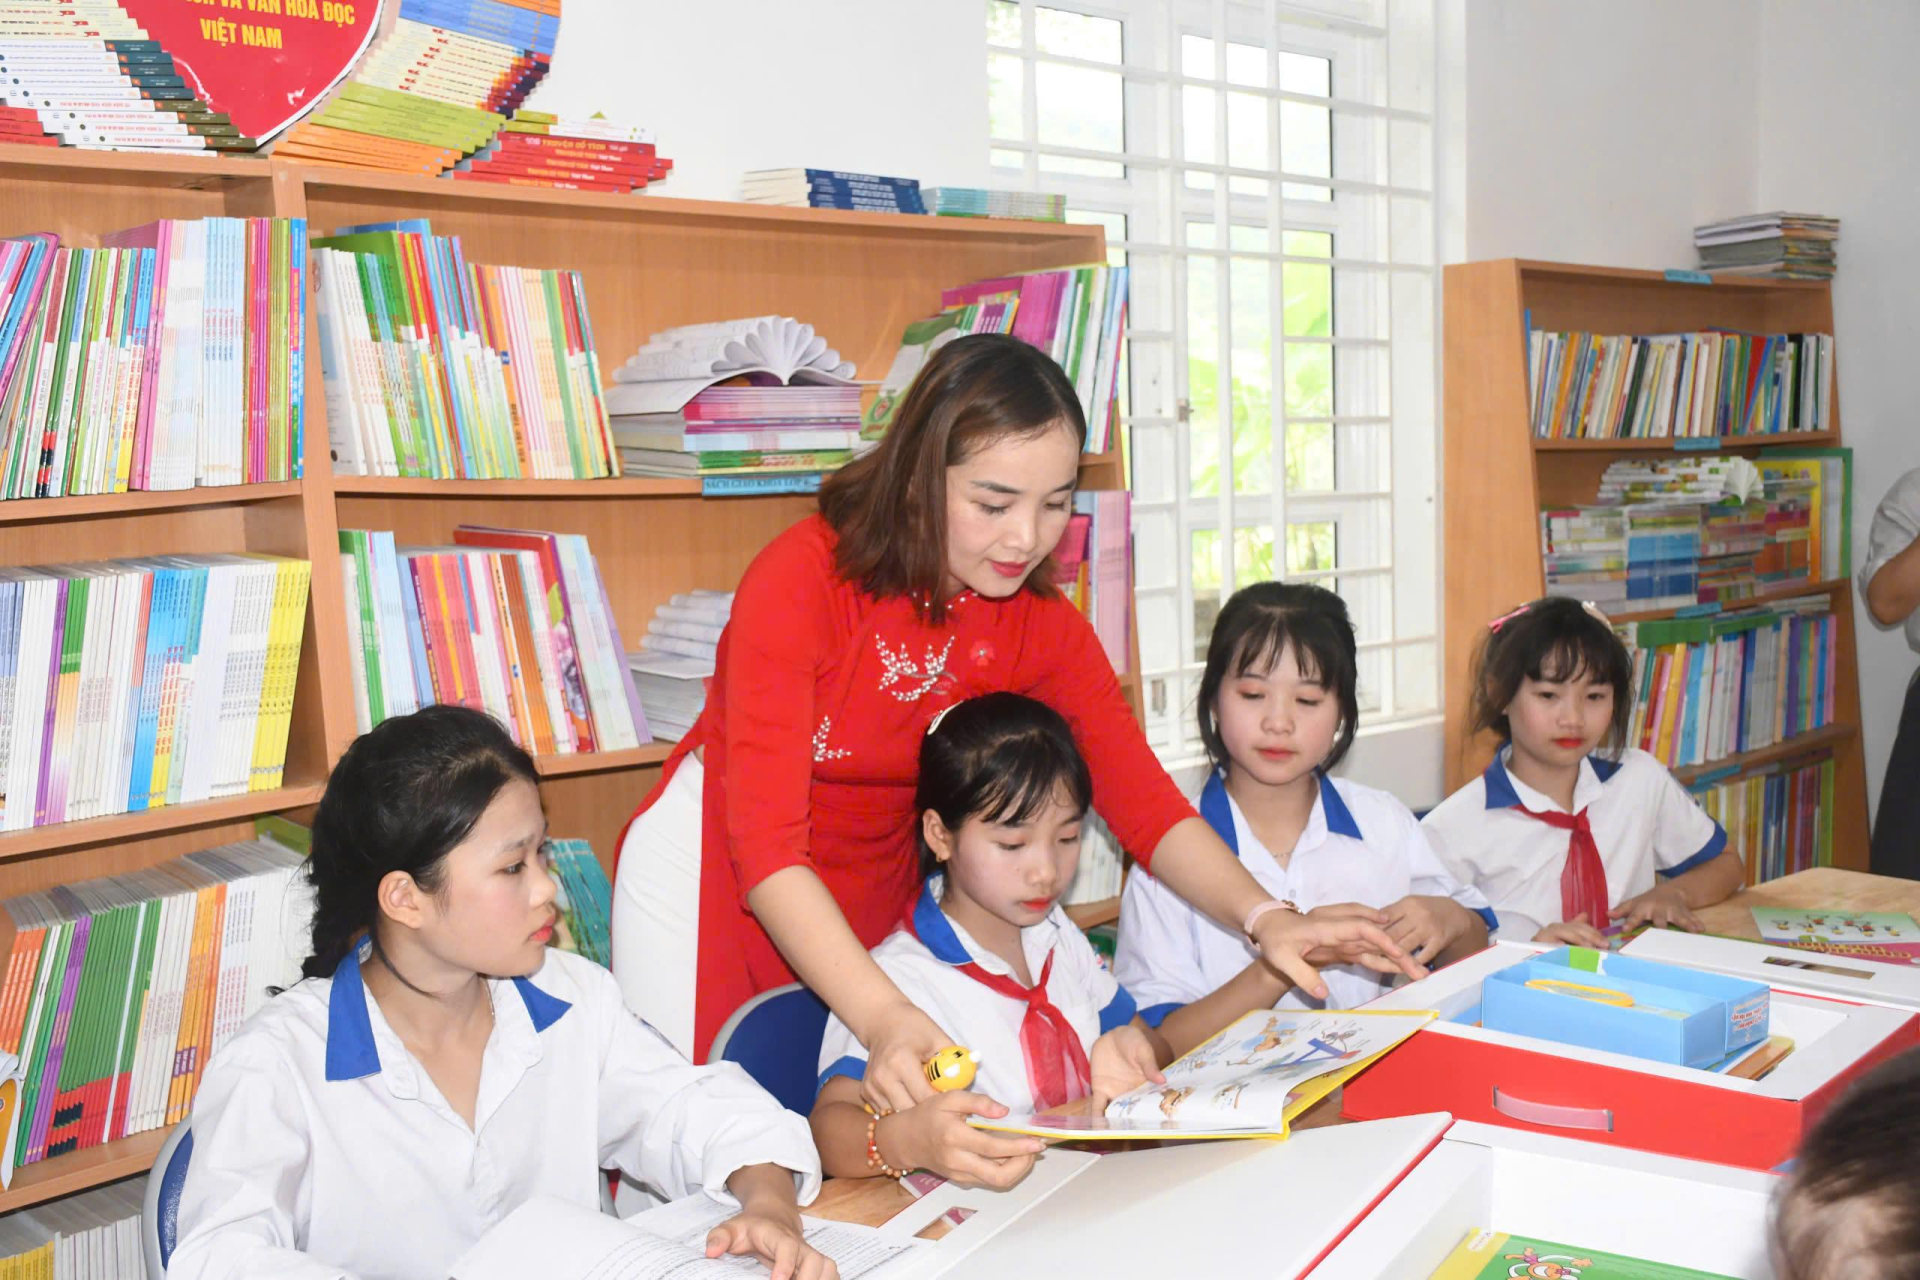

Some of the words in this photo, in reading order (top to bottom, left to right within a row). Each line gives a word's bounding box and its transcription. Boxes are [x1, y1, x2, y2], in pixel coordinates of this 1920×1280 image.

[322, 1, 355, 28] ĐỌC
[200, 17, 236, 47] VIỆT
[242, 25, 283, 49] NAM
